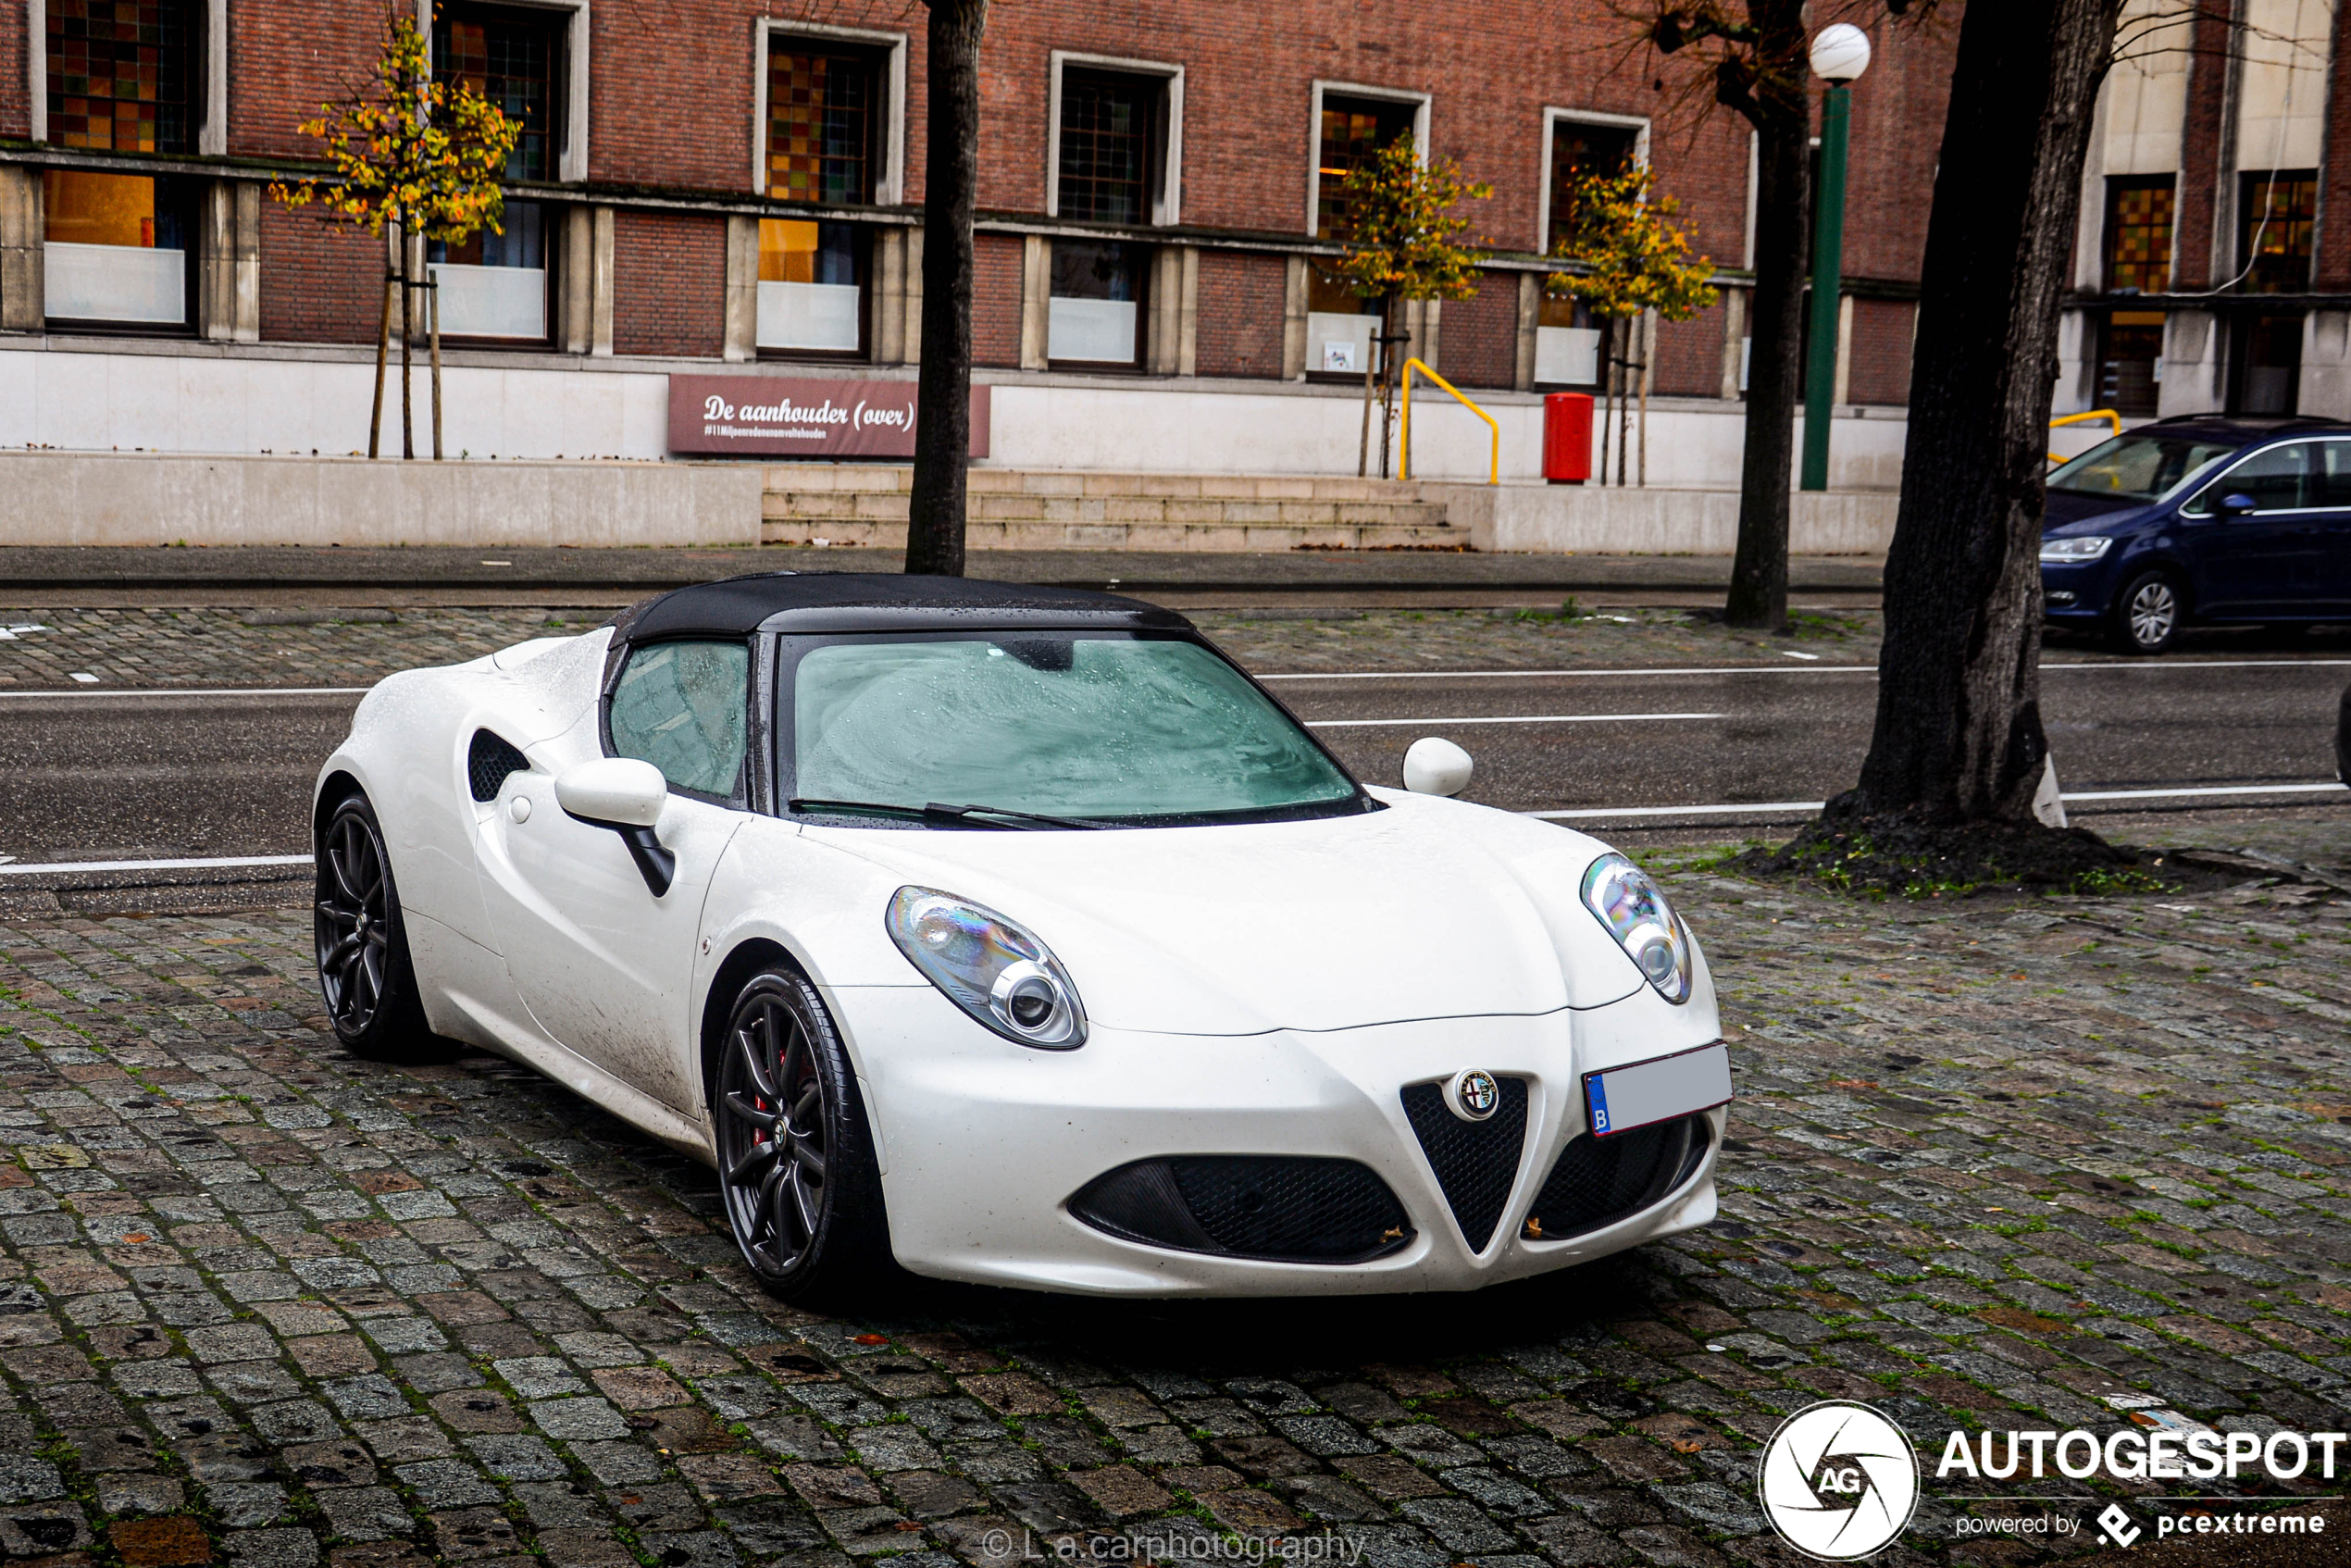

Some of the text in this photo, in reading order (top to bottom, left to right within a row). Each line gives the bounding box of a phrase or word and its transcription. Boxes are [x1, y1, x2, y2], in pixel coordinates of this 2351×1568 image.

[703, 395, 914, 431] De aanhouder (over)
[1595, 1110, 1607, 1128] B
